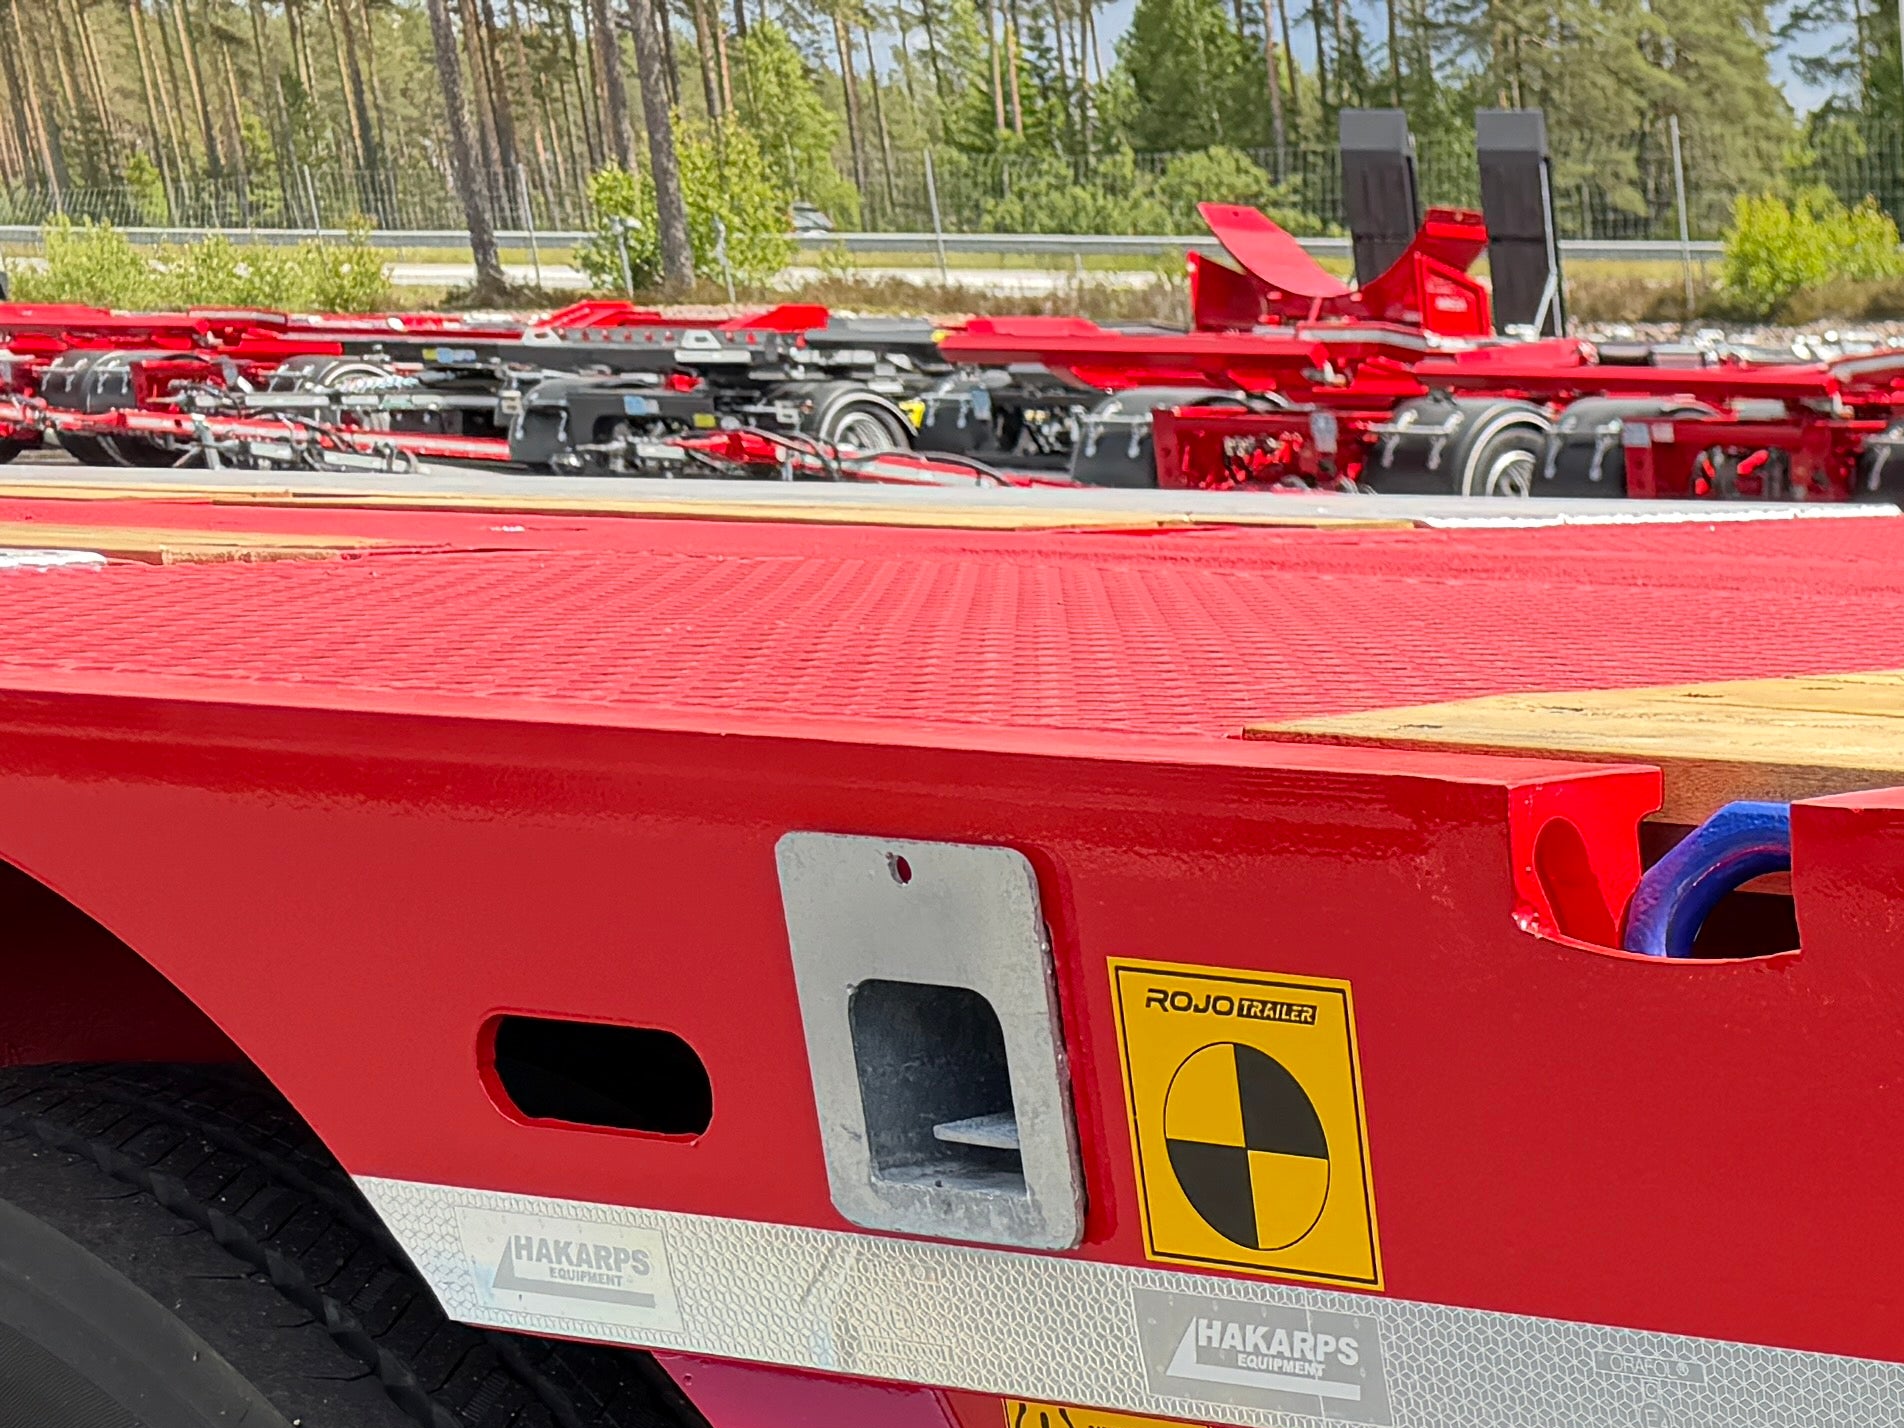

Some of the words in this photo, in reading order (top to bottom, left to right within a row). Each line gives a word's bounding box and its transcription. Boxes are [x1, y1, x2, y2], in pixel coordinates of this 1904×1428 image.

[1145, 987, 1235, 1017] ROJO
[1240, 999, 1315, 1024] TRAILER
[513, 1235, 651, 1276] HAKARPS
[550, 1267, 624, 1287] EQUIPMENT
[1198, 1318, 1360, 1365] HAKARPS
[1236, 1352, 1327, 1377] EQUIPMENT
